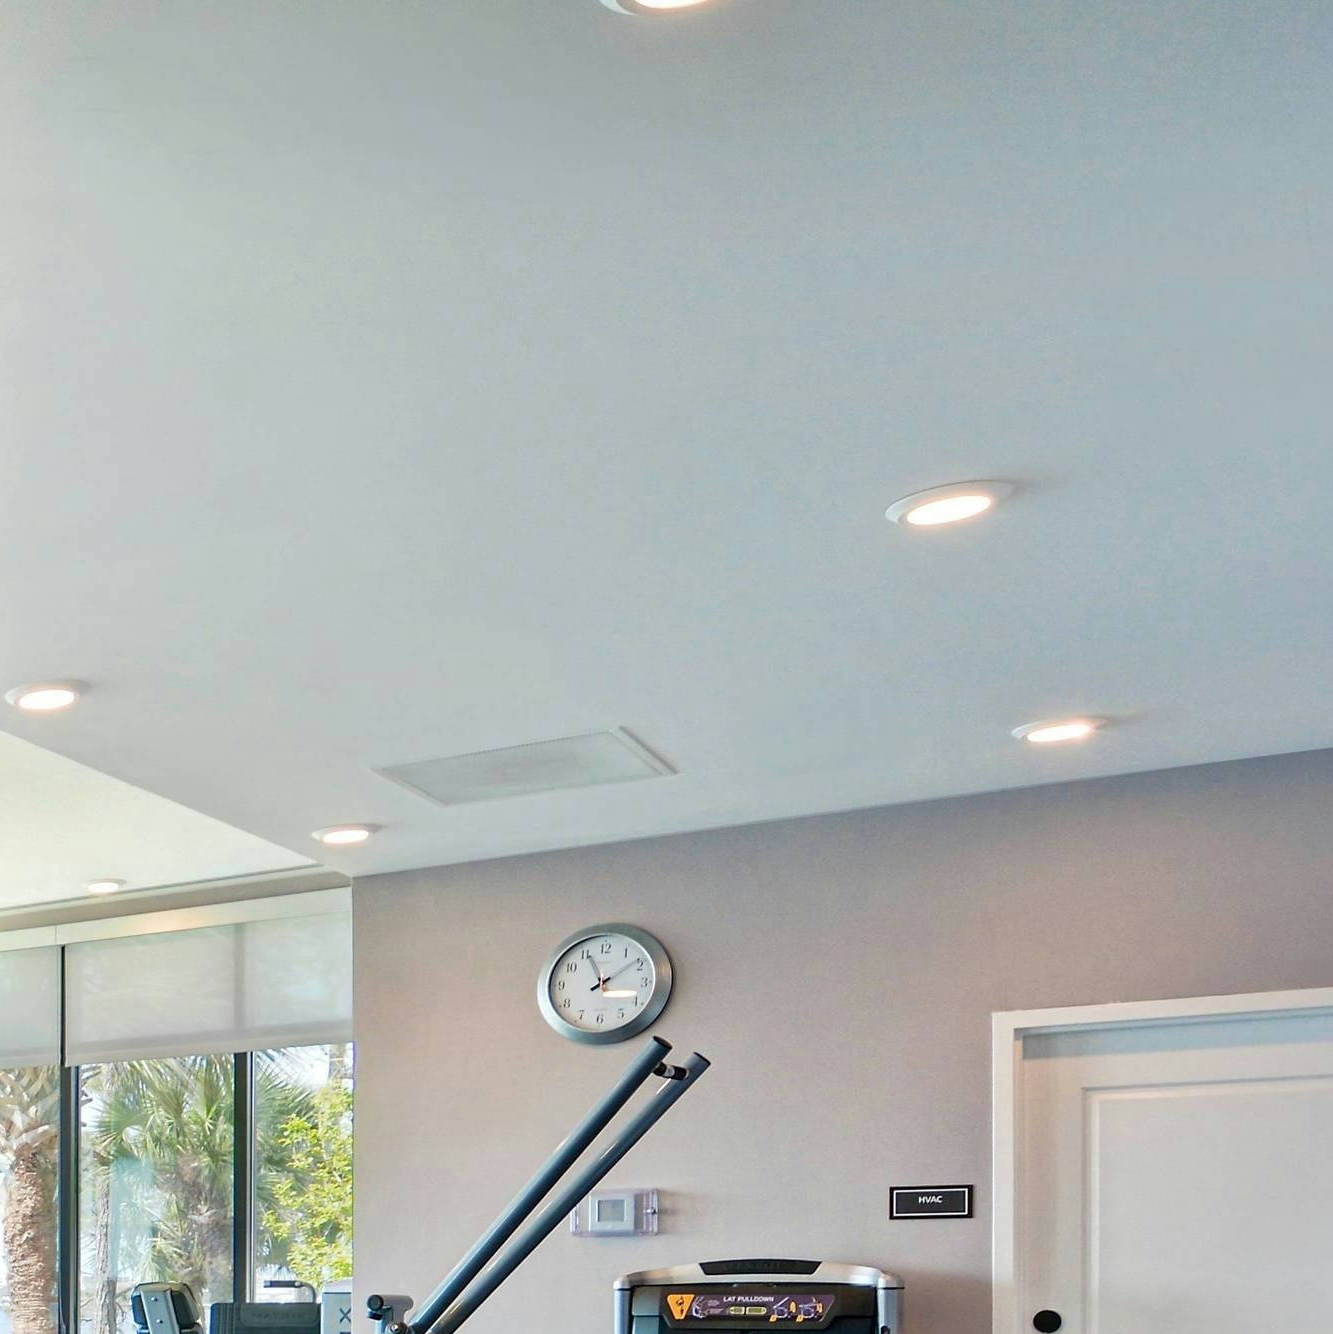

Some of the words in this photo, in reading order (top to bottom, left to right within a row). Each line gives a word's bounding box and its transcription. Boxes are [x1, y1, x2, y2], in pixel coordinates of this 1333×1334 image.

[600, 943, 612, 954] 12
[624, 948, 628, 958] 1
[581, 949, 591, 960] 11
[566, 962, 577, 973] 10
[636, 958, 644, 971] 2
[558, 980, 565, 991] 9
[640, 977, 648, 988] 3
[563, 999, 571, 1008] 8
[578, 1009, 585, 1020] 7
[596, 1013, 604, 1025] 6
[617, 1008, 624, 1019] 5
[918, 1195, 943, 1204] HVAC
